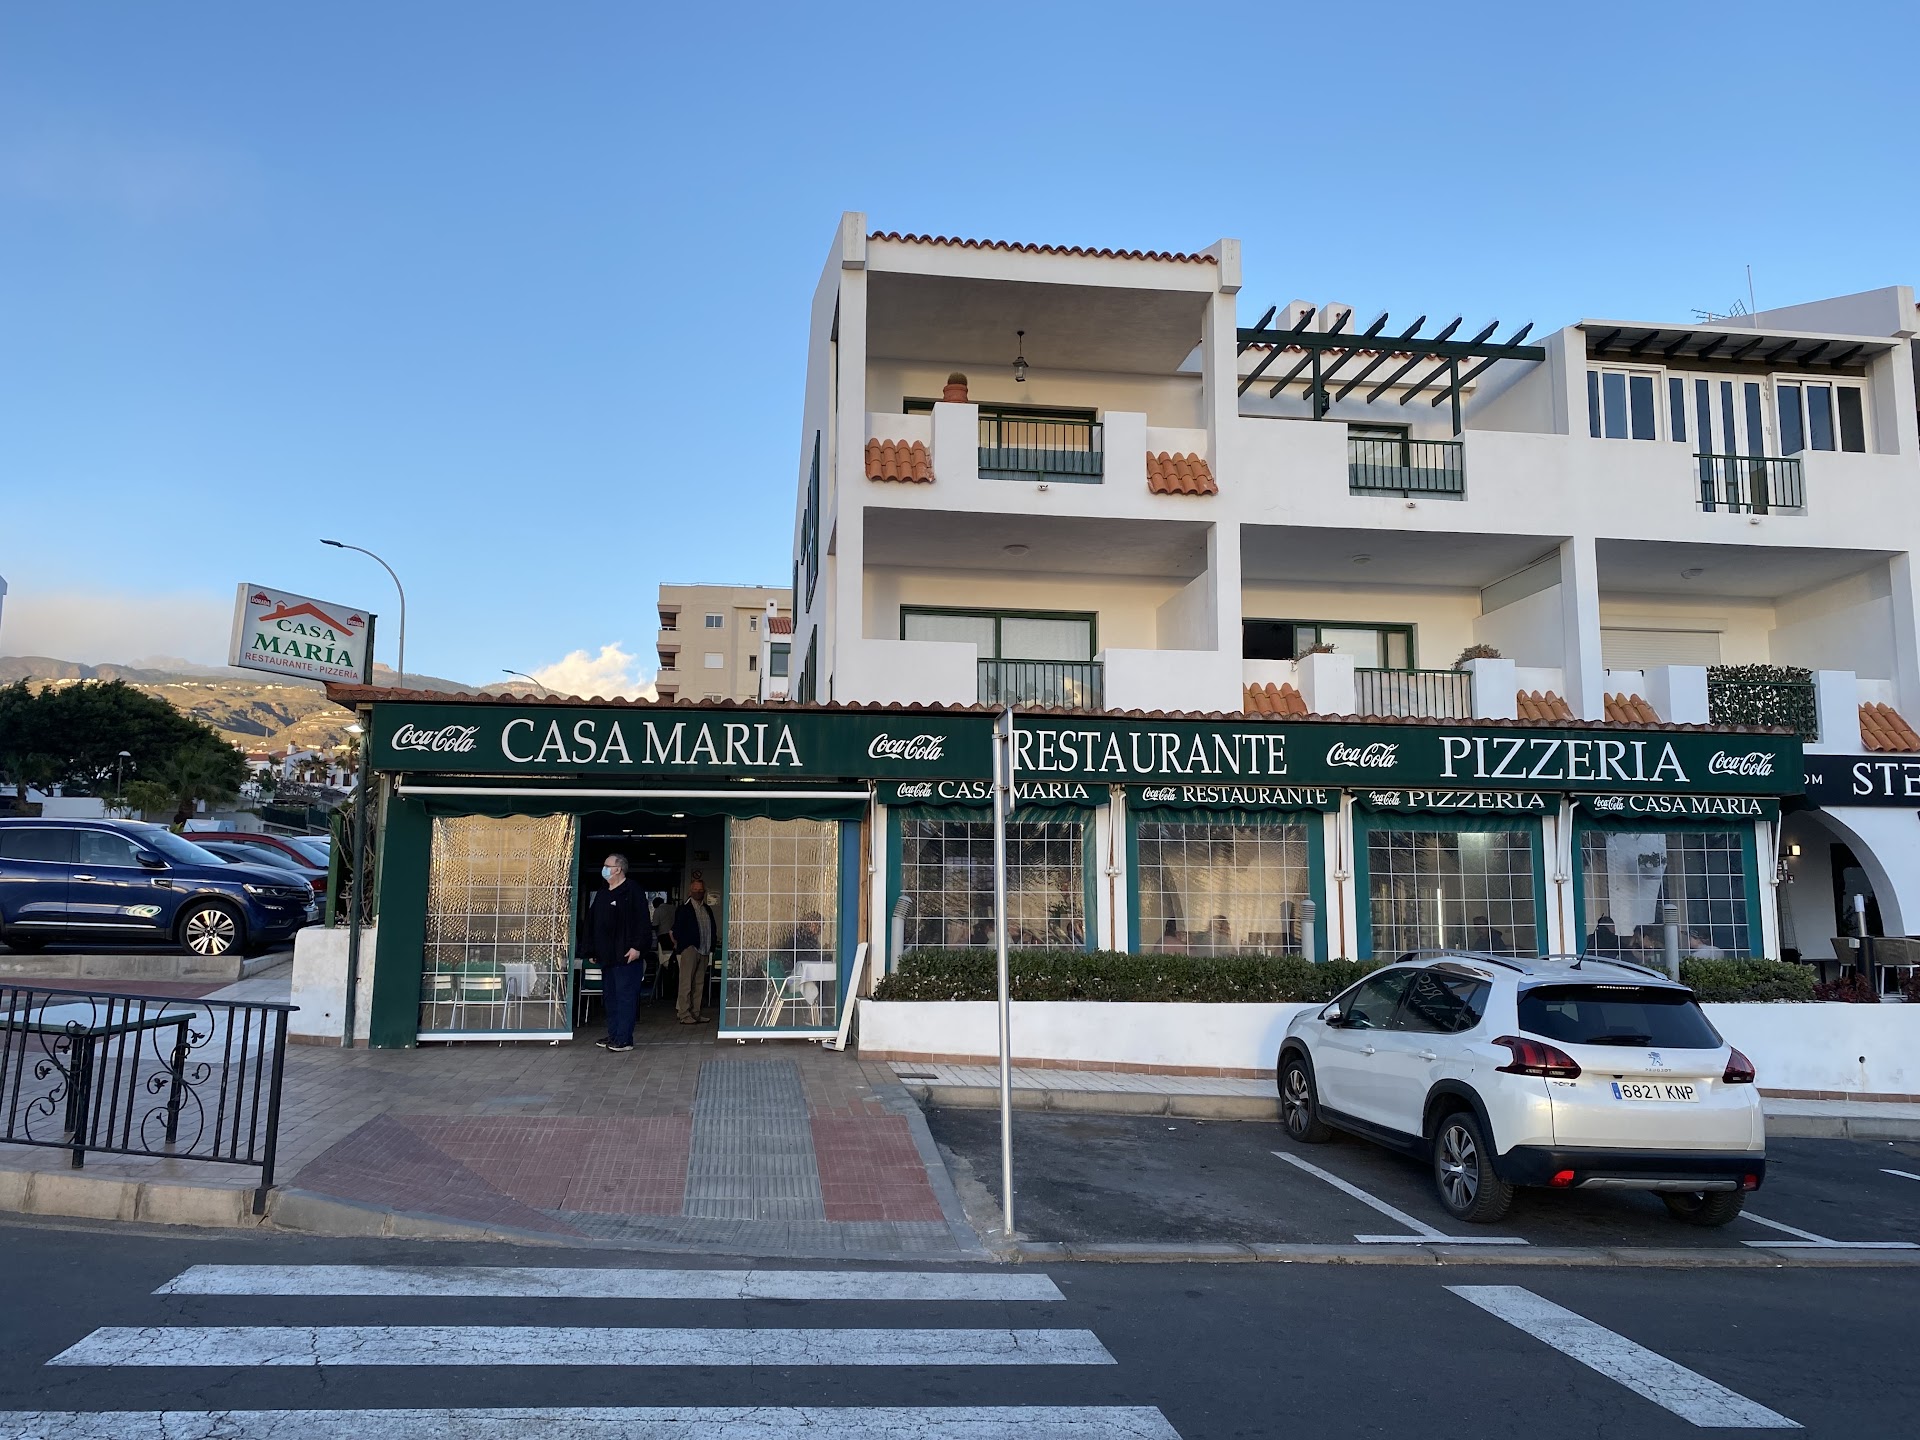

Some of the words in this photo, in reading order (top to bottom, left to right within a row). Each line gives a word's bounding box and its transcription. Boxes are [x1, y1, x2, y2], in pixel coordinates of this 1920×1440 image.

[276, 619, 337, 642] CASA
[245, 652, 313, 672] RESTAURANTE
[251, 632, 354, 668] MARÍA
[391, 723, 481, 753] Coca-Cola
[501, 718, 634, 764] CASA
[642, 721, 804, 767] MARIA
[867, 733, 948, 761] Coca-Cola
[1013, 729, 1288, 775] RESTAURANTE
[1326, 741, 1400, 768] Coca-Cola
[1438, 736, 1691, 783] PIZZERIA
[1708, 750, 1776, 777] Coca-Cola
[896, 782, 933, 798] Coca-Cola
[1014, 782, 1089, 800] MARIA
[1142, 786, 1177, 801] Coca-Cola
[1182, 785, 1328, 805] RESTAURANTE
[1405, 790, 1546, 809] PIZZERIA
[1629, 795, 1688, 814] CASA
[1691, 797, 1763, 815] MARIA
[1622, 1084, 1661, 1099] 6821
[1664, 1085, 1694, 1100] KNP
